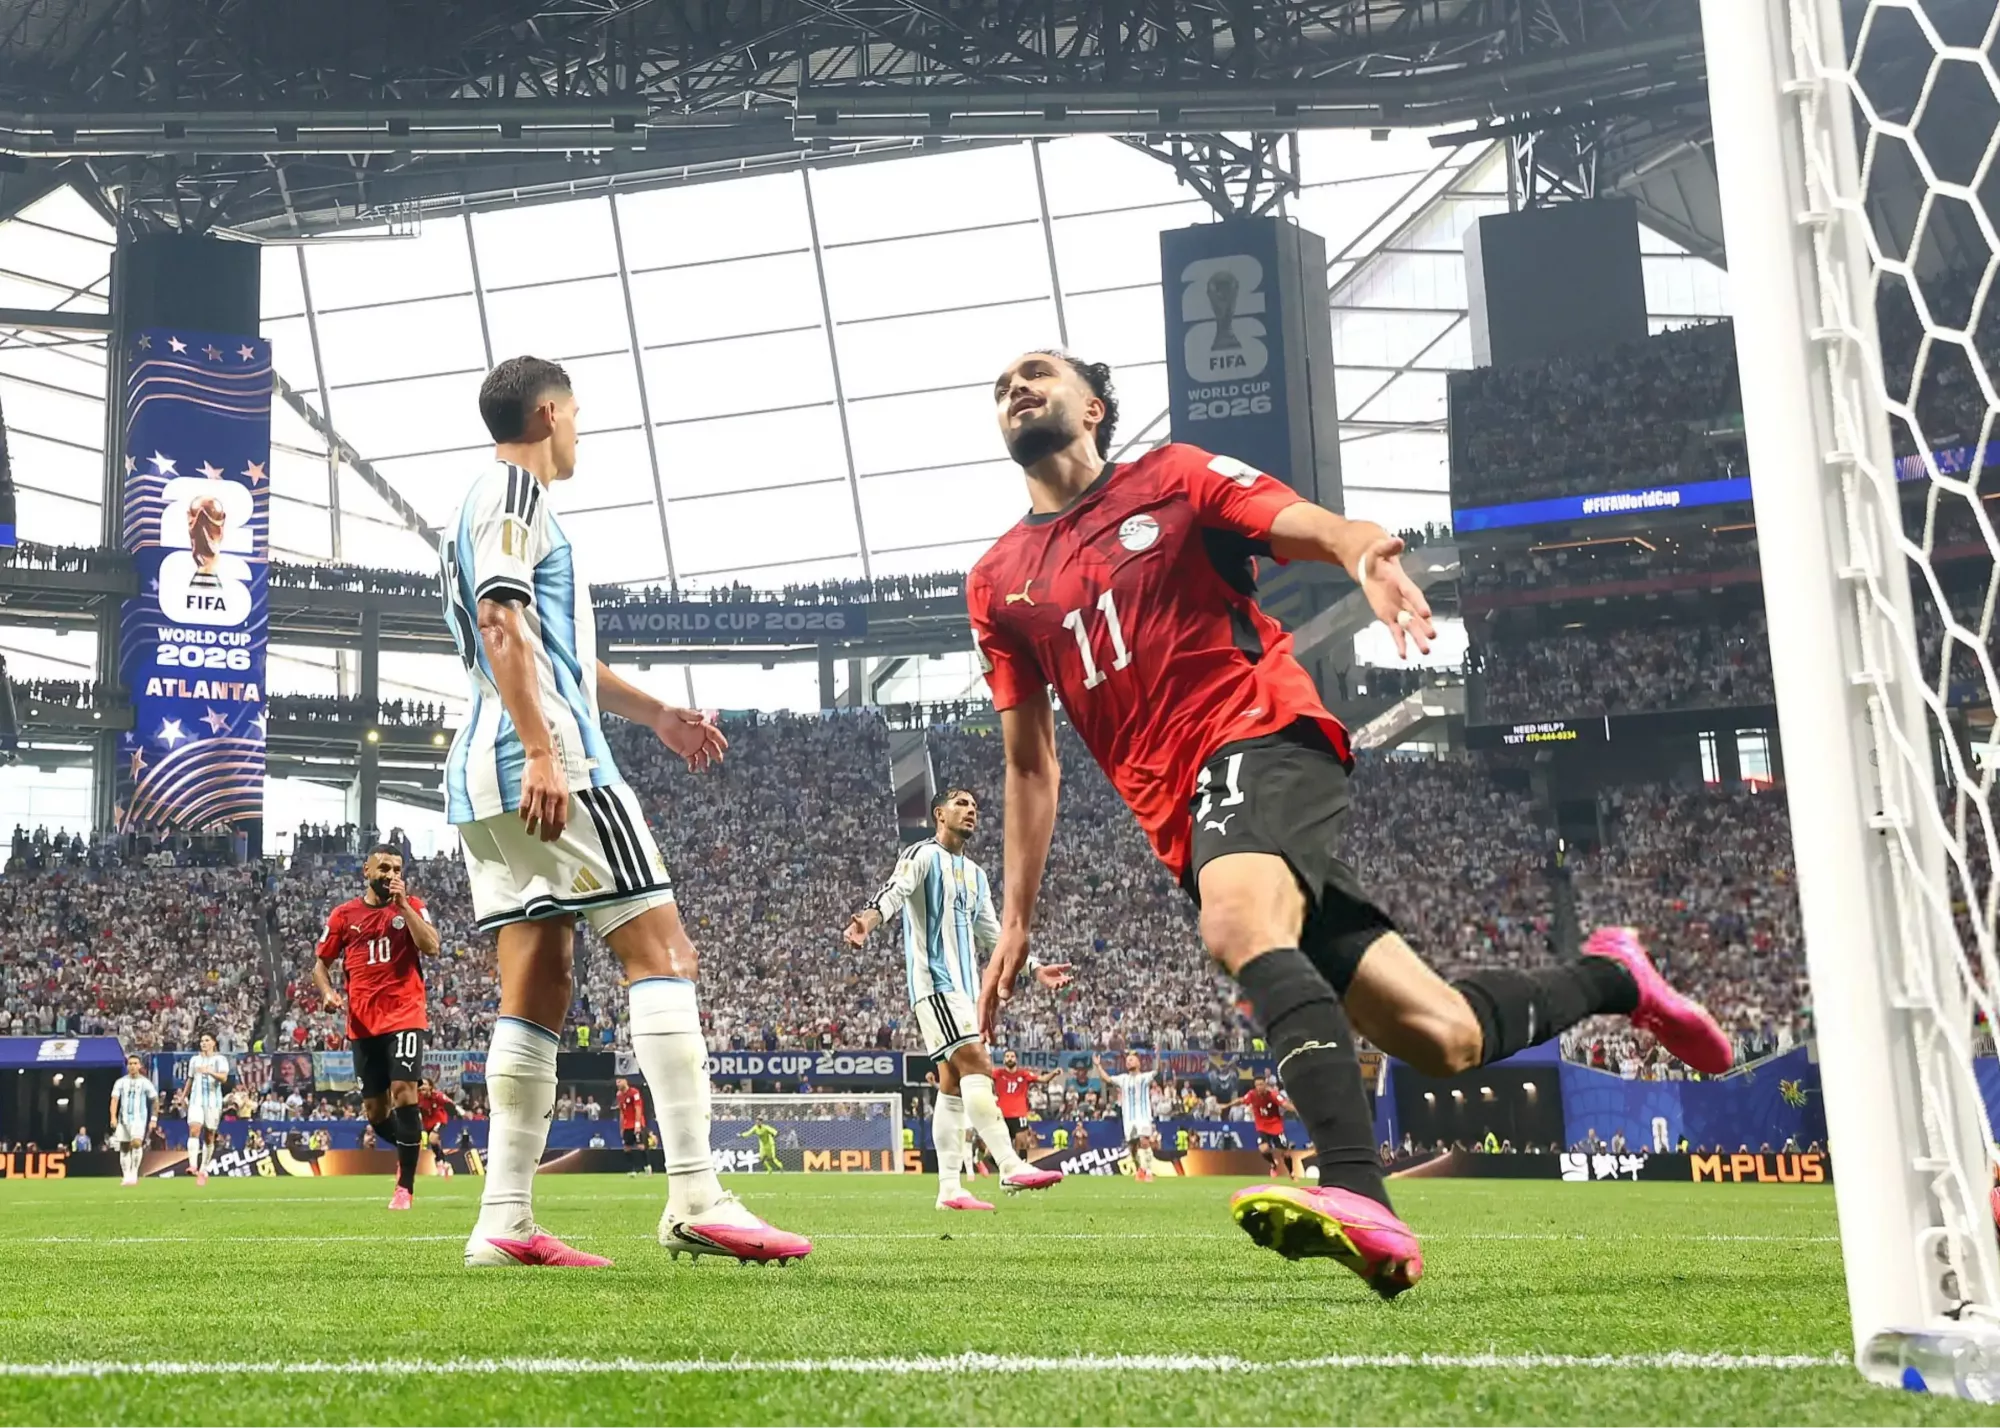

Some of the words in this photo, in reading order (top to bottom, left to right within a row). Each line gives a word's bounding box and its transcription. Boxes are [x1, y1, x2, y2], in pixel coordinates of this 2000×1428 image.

[1209, 354, 1246, 371] FIFA
[1188, 384, 1239, 401] WORLD
[1242, 381, 1271, 395] CUP
[1188, 394, 1272, 421] 2026
[1582, 490, 1680, 514] #FIFAWorldCup
[186, 595, 226, 611] FIFA
[597, 613, 624, 631] FA
[627, 613, 710, 631] WORLD
[714, 612, 760, 631] CUP
[764, 612, 846, 630] 2026
[158, 627, 217, 644] WORLD
[218, 631, 251, 647] CUP
[1062, 588, 1132, 691] 11
[156, 644, 251, 671] 2026
[145, 677, 260, 702] ATLANTA
[1513, 724, 1536, 734] NEED
[1537, 722, 1565, 733] HELP?
[1503, 735, 1524, 744] TEXT
[367, 936, 391, 965] 10
[395, 1031, 417, 1058] 10
[708, 1056, 764, 1075] ORLD
[767, 1056, 812, 1075] CUP
[816, 1055, 894, 1075] 2026
[1007, 1081, 1018, 1094] 17
[1690, 1153, 1824, 1183] M-PLUS
